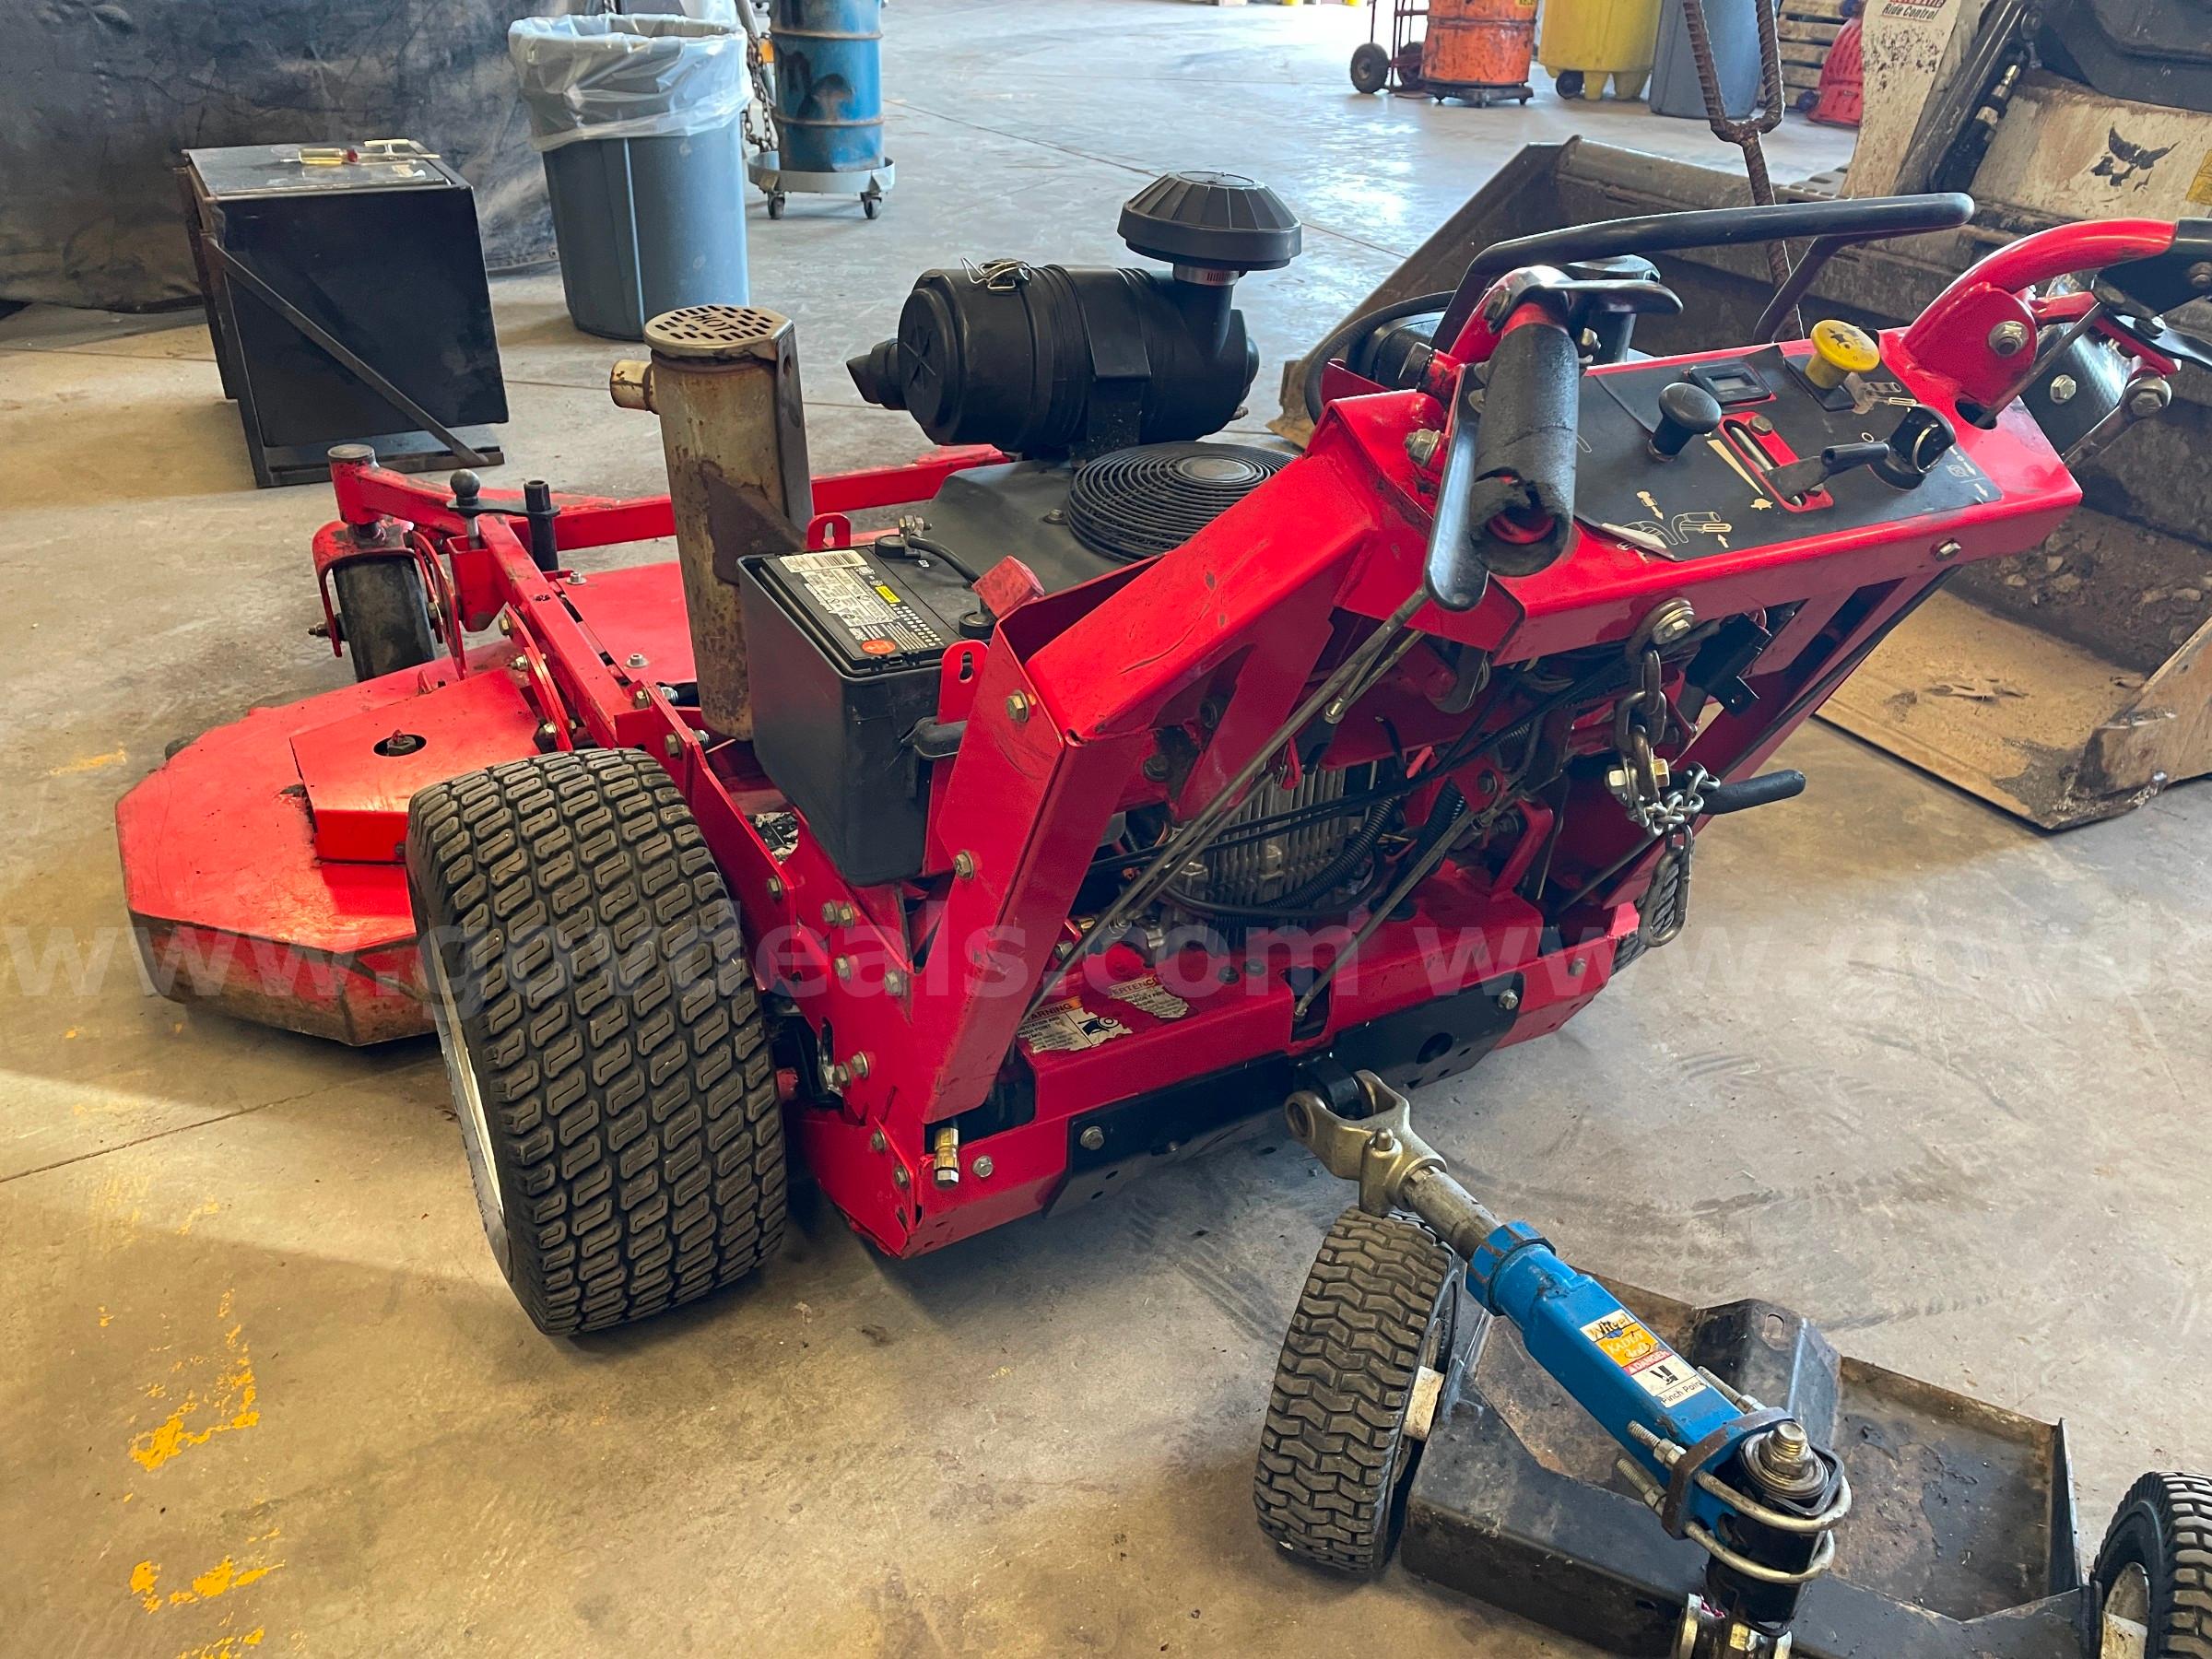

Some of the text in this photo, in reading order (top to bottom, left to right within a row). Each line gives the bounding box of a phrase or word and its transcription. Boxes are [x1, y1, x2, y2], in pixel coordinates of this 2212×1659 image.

[1882, 3, 1904, 16] Ride
[1903, 6, 1939, 19] Control
[1027, 1003, 1073, 1021] ARNING
[1661, 1387, 1684, 1404] Pinch
